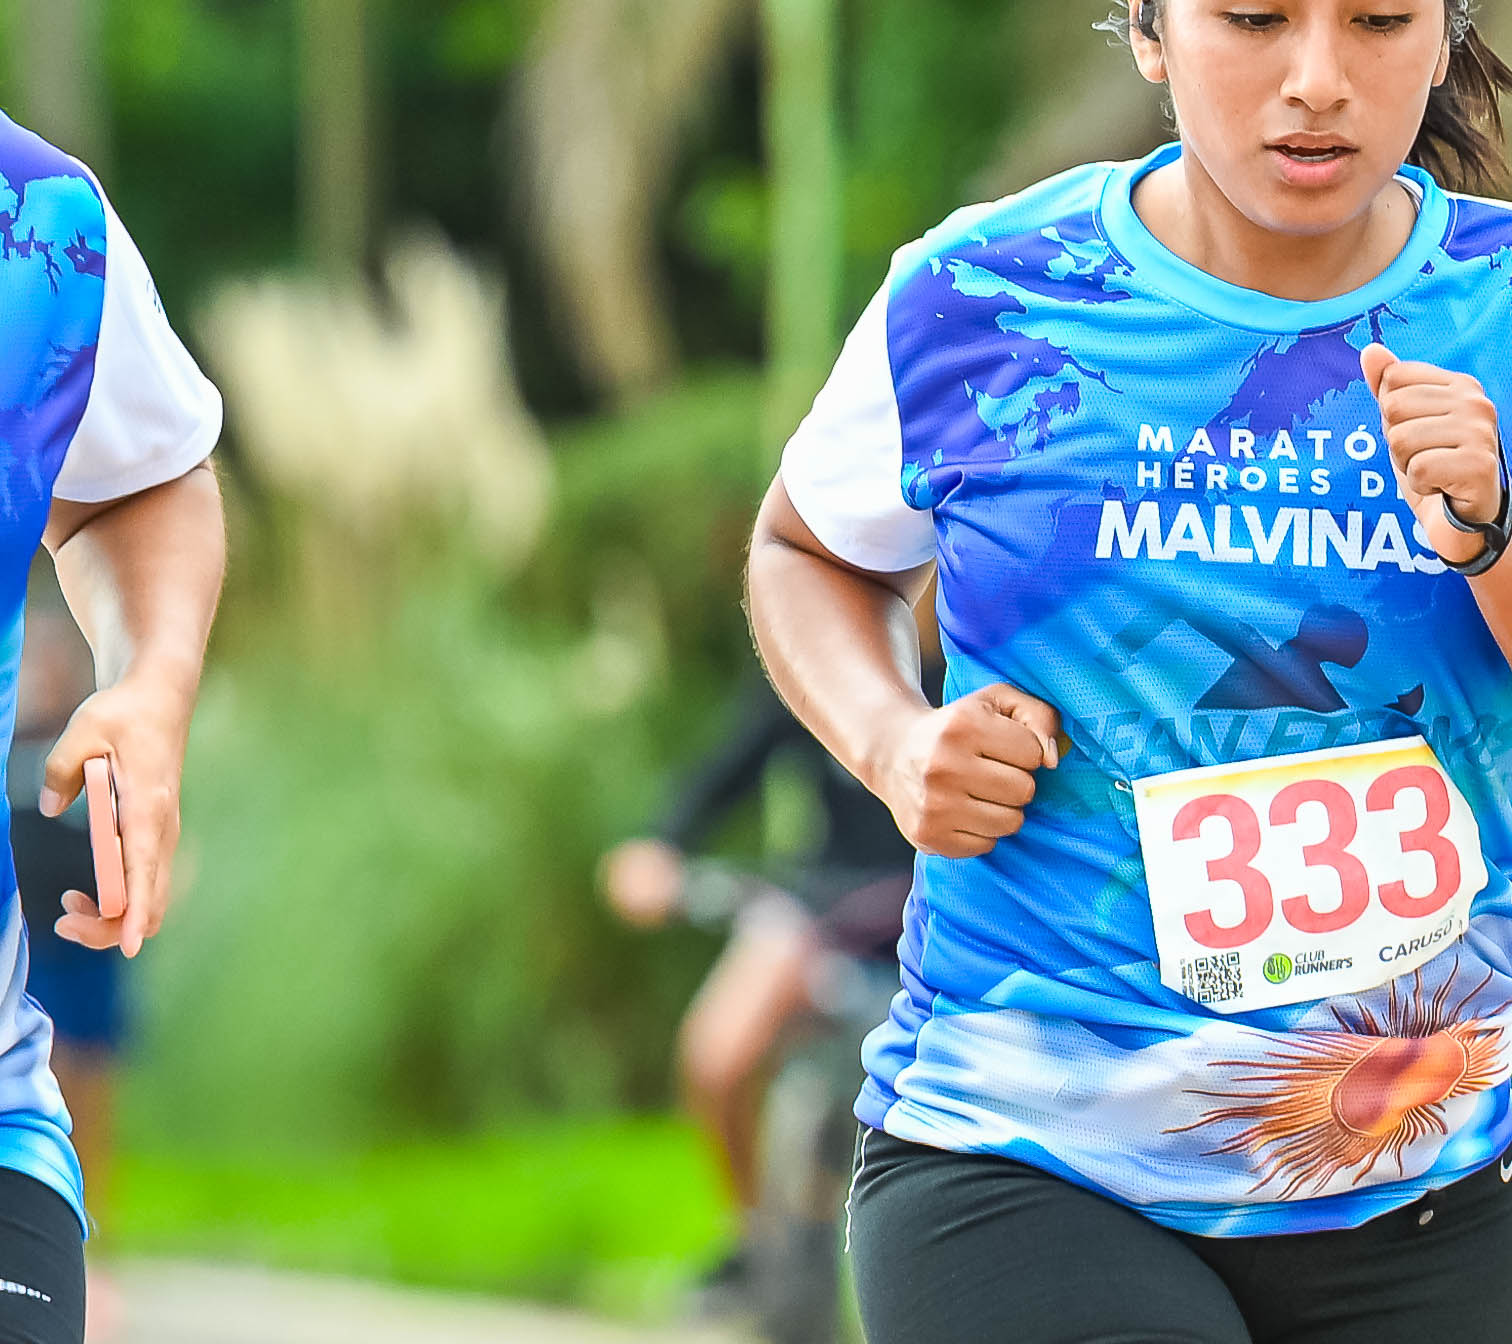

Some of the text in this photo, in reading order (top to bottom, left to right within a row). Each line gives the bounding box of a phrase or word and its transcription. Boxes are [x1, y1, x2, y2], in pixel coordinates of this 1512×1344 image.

[1136, 424, 1377, 461] MARATÓ
[1136, 457, 1405, 500] HÉROES D
[1171, 764, 1462, 950] 333
[1378, 918, 1453, 963] CARUSO
